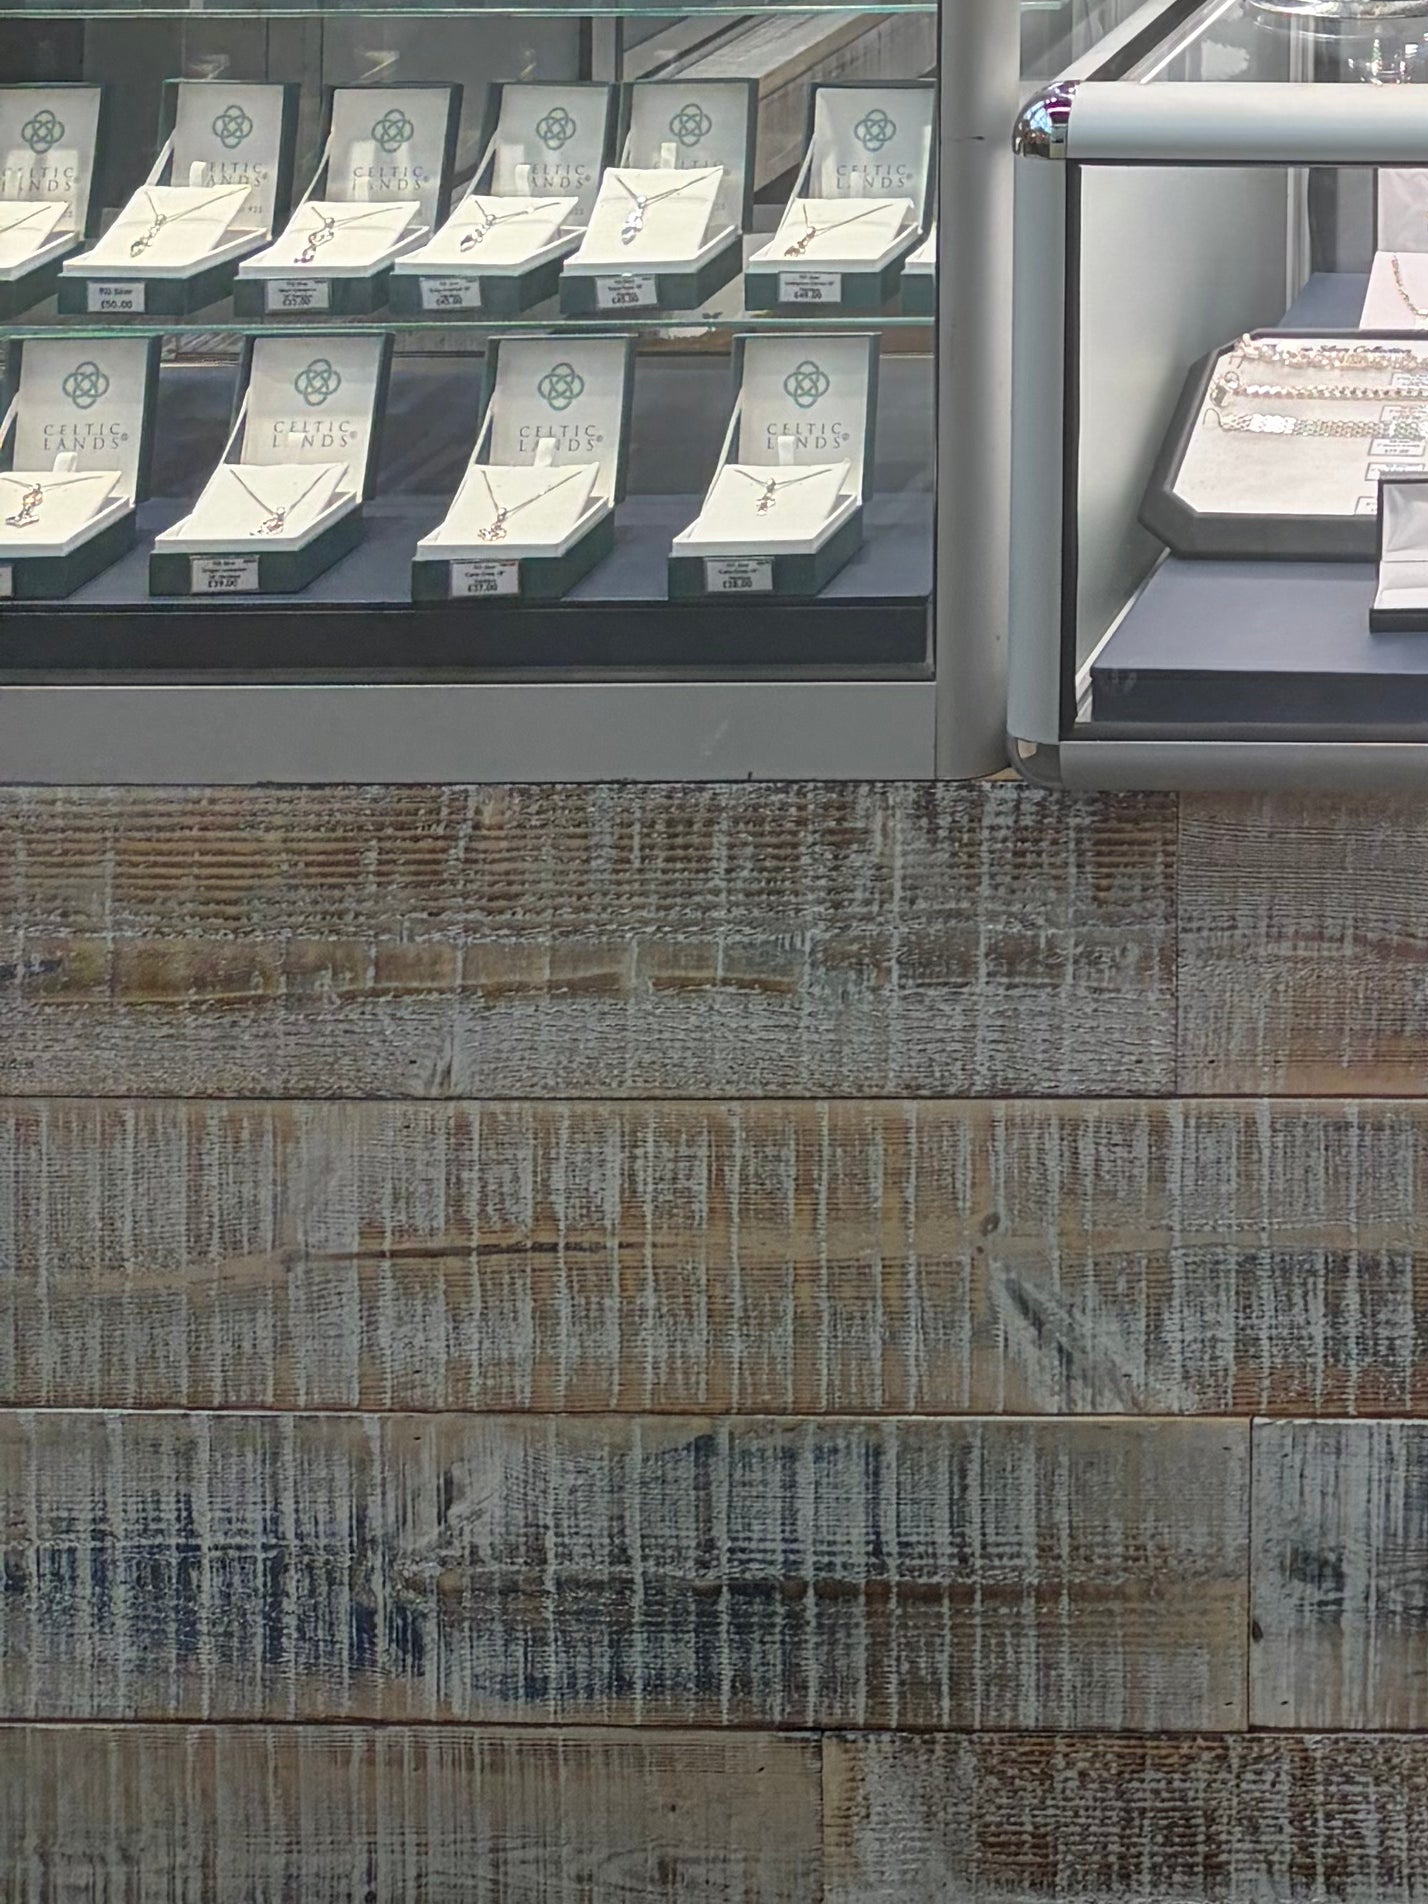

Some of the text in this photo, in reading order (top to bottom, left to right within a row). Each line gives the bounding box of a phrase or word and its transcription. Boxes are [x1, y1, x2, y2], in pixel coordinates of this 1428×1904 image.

[209, 162, 263, 173] ELTIC
[531, 164, 585, 175] ELTIC
[44, 423, 120, 436] CELTIC
[274, 420, 350, 433] CELTIC
